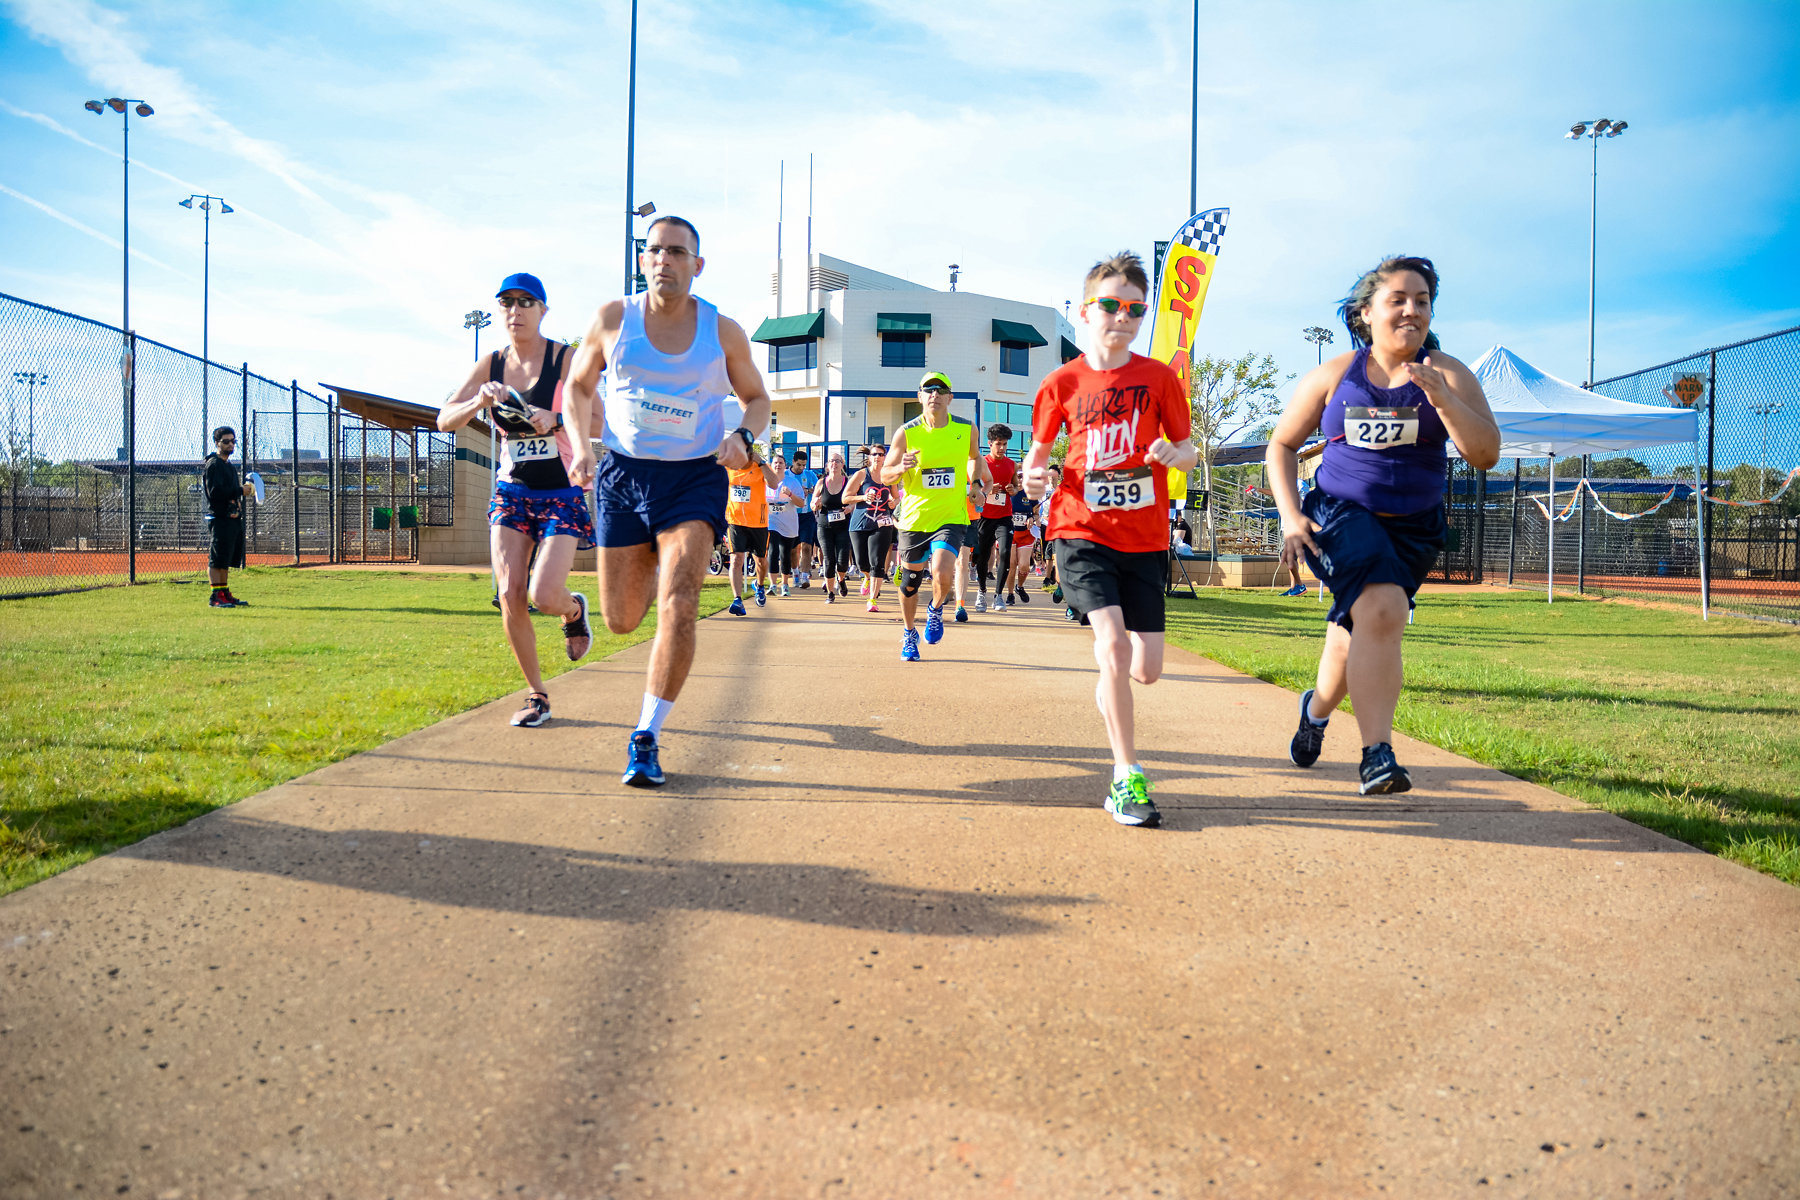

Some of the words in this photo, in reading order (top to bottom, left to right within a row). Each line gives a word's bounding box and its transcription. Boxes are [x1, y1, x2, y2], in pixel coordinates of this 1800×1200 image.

[1682, 374, 1697, 383] NO
[1674, 383, 1704, 393] WARM
[1682, 393, 1695, 402] UP
[641, 401, 670, 413] FLEET
[670, 407, 694, 419] FEET
[1085, 407, 1140, 470] WIN
[1358, 422, 1405, 444] 227
[516, 439, 549, 457] 242
[928, 474, 950, 487] 276
[733, 489, 747, 497] 298
[1097, 482, 1141, 506] 259
[1194, 494, 1203, 508] 2
